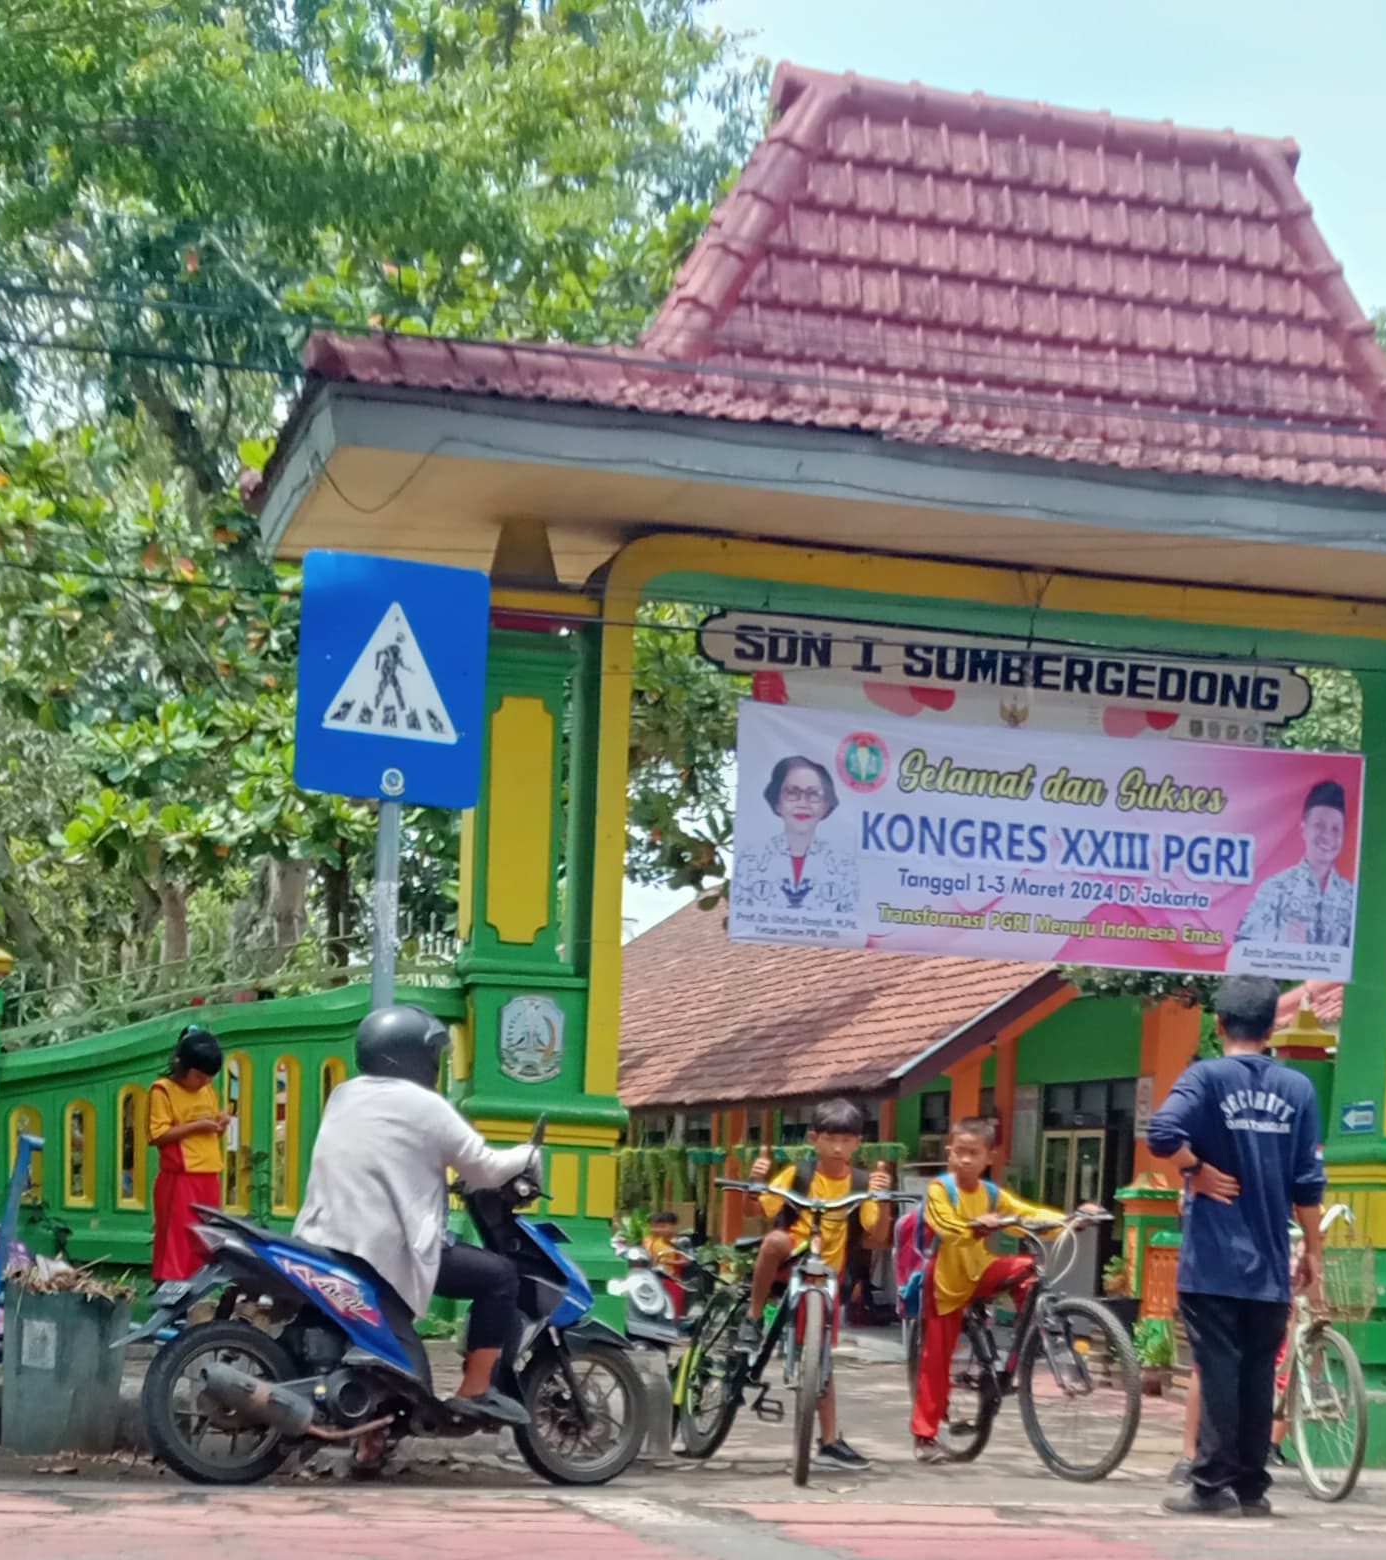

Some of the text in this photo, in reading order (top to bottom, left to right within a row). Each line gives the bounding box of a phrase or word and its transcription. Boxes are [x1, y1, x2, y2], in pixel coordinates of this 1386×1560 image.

[734, 625, 831, 668] SDN
[903, 643, 1281, 712] SUMBERGEDONG
[898, 748, 1227, 814] Selamat dan Sukses
[860, 810, 1251, 879] KONGRES XXIII PGRI
[898, 868, 1210, 908] Tanggal 1-3 Maret 2024 Di Jakarta
[876, 903, 1224, 946] Transformasi PGRI Menuju Indonesia Emas
[1219, 1088, 1295, 1122] SECURITY
